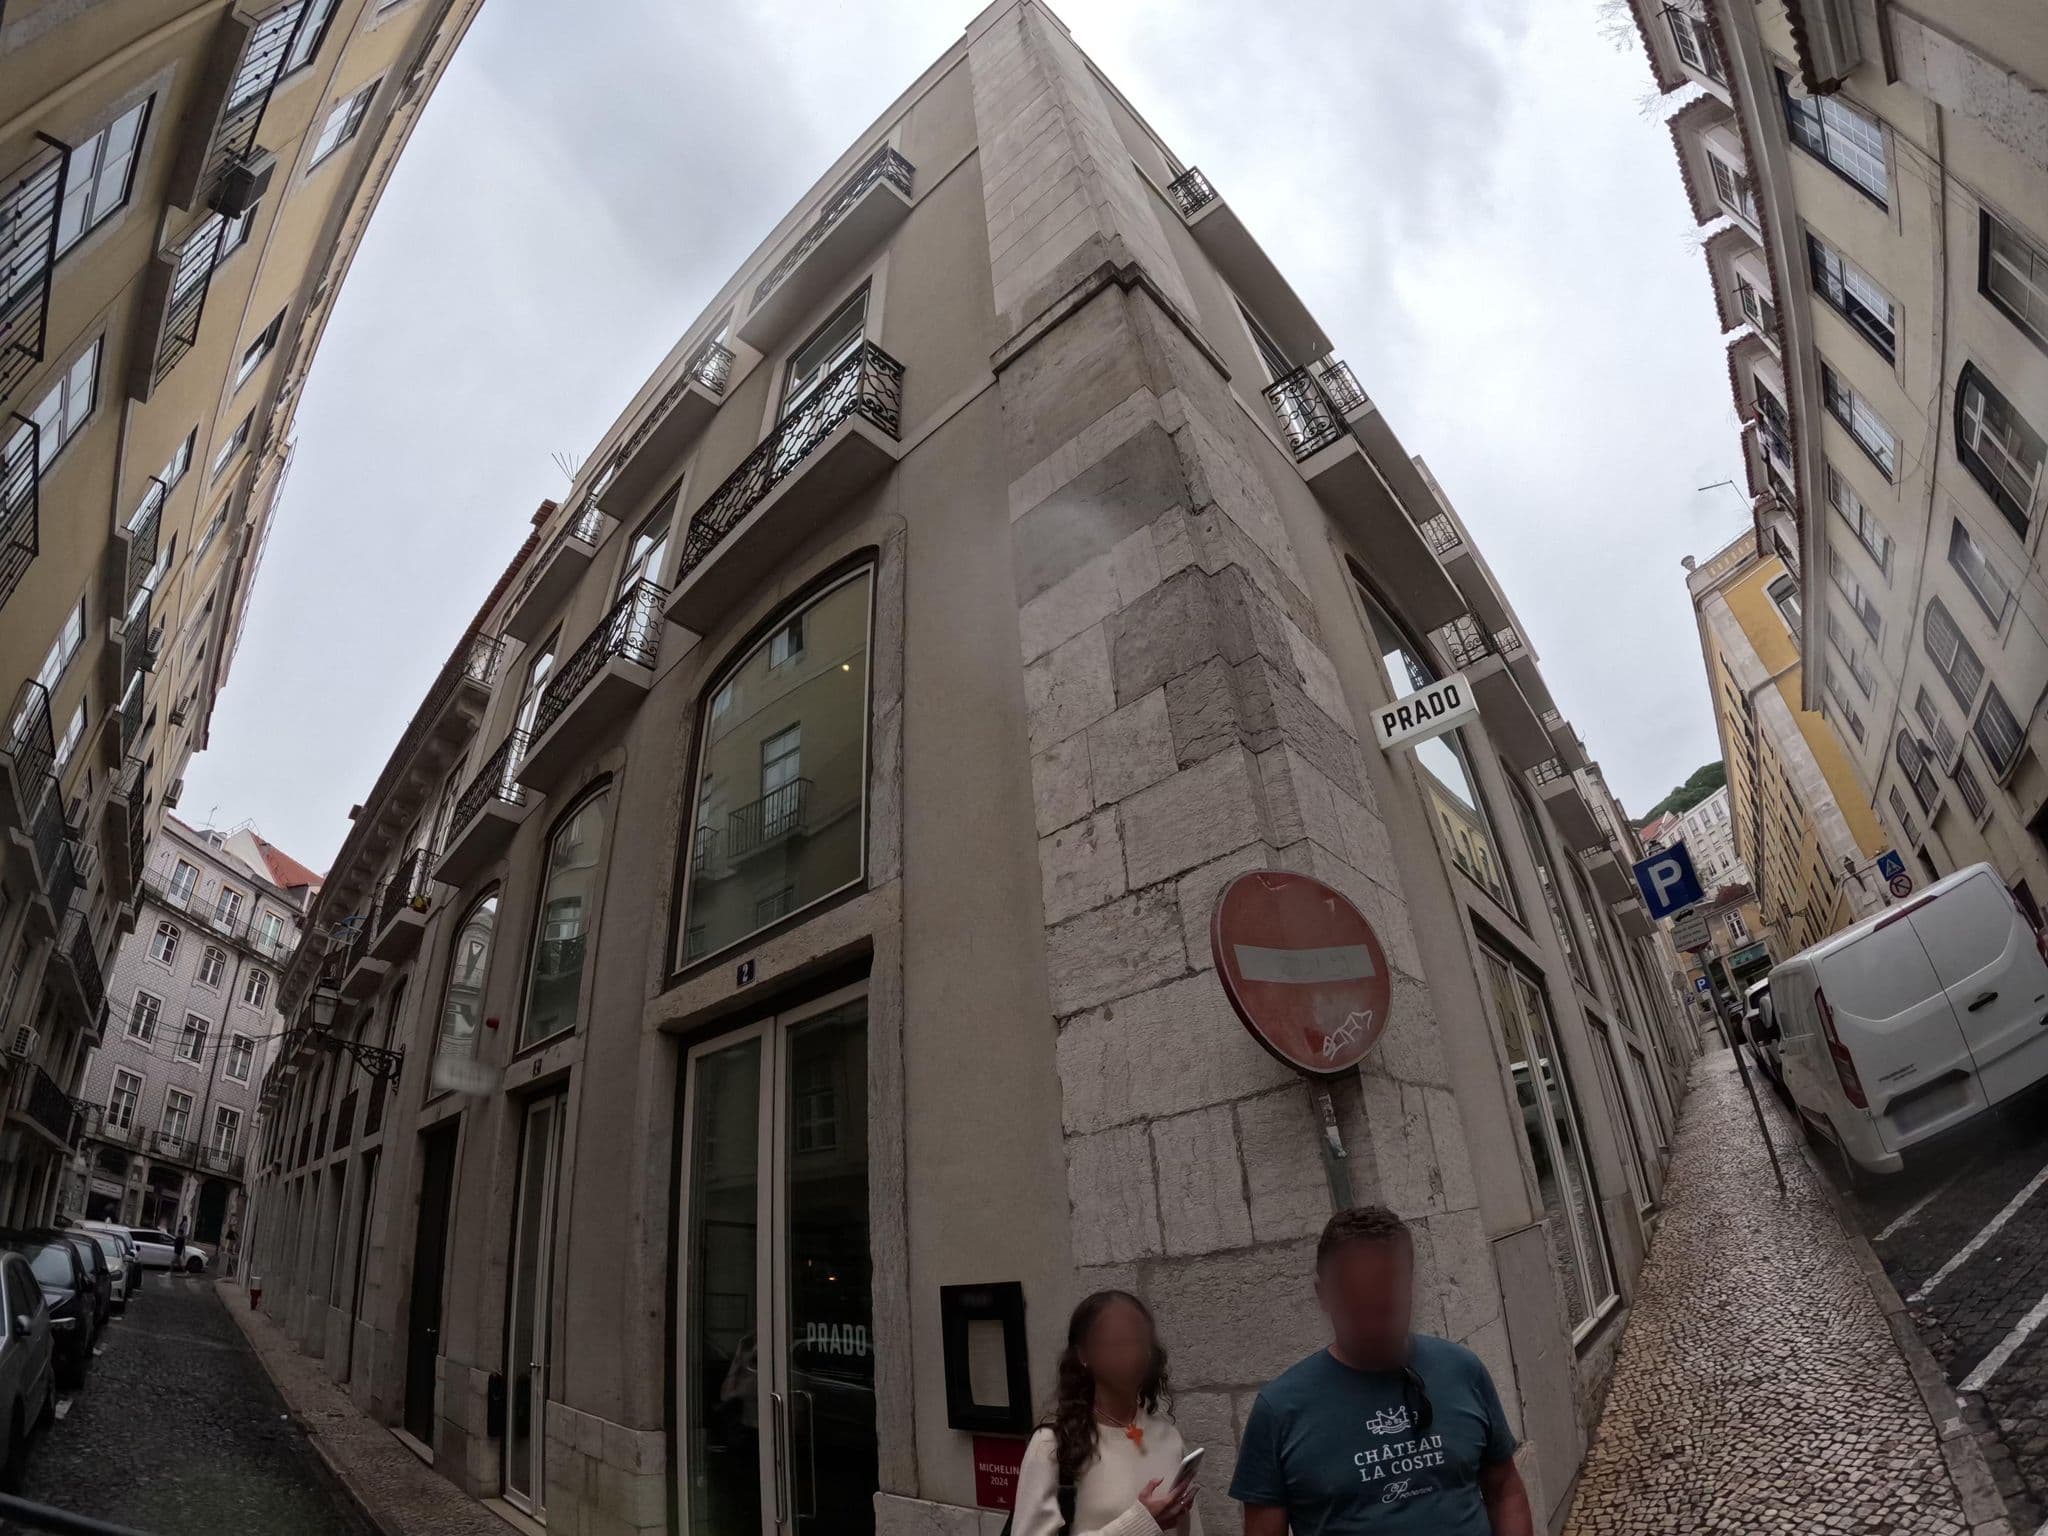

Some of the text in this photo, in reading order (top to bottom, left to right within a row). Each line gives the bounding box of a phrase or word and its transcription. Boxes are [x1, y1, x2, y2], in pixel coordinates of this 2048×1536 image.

[1382, 684, 1460, 737] PRADO
[1648, 858, 1682, 907] P
[741, 963, 749, 982] 2
[1697, 979, 1706, 992] P
[806, 1322, 867, 1357] PRADO
[1354, 1435, 1443, 1466] CHÂTEAU
[979, 1463, 1020, 1475] MICHELIN
[991, 1476, 1008, 1486] 2024
[1359, 1451, 1445, 1482] LA COSTE
